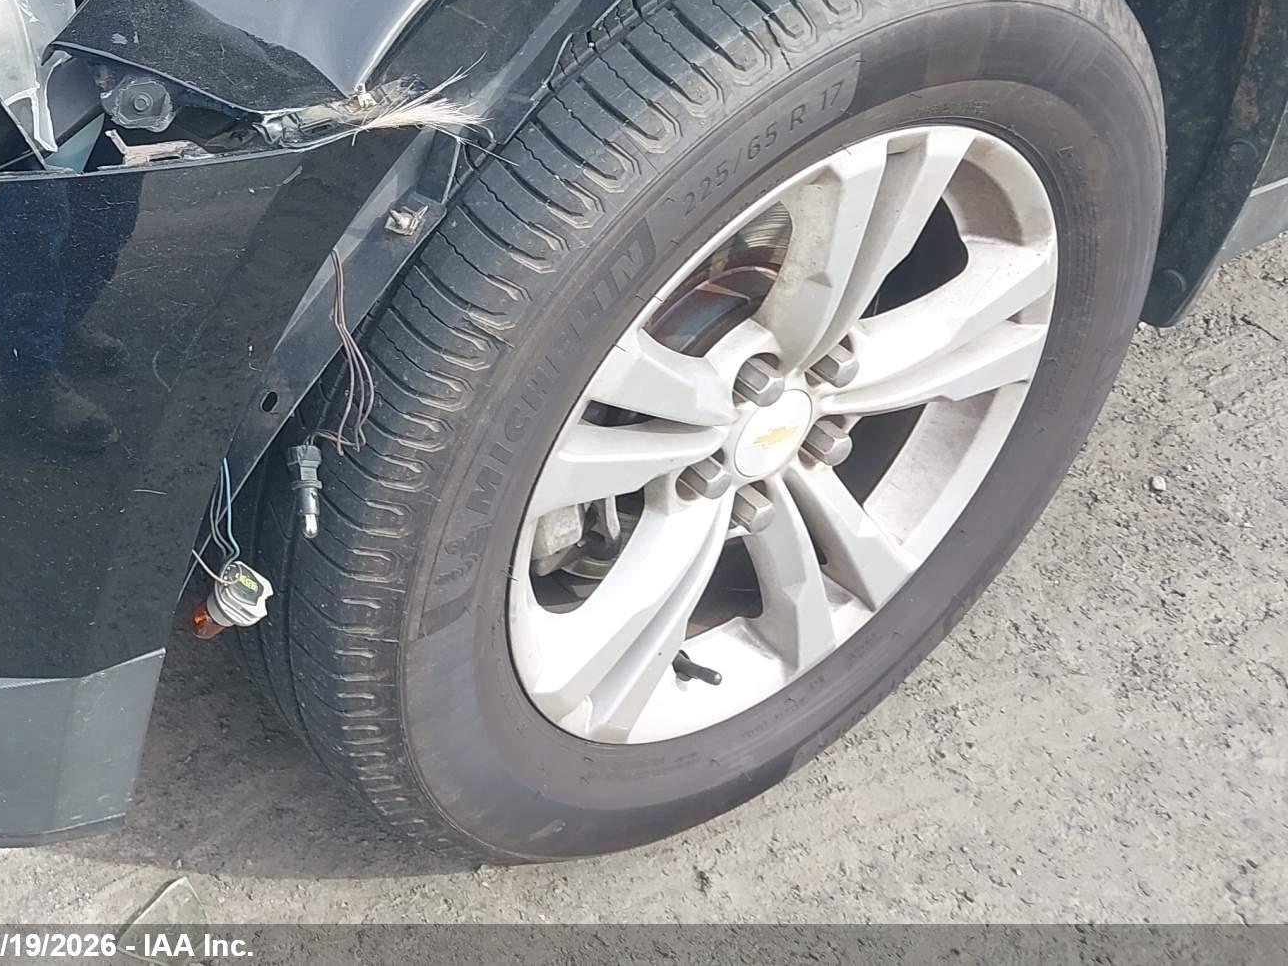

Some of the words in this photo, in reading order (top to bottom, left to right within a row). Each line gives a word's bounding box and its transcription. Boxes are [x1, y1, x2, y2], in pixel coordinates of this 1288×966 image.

[684, 121, 778, 216] 225/65
[790, 103, 806, 130] R
[820, 80, 844, 111] 17
